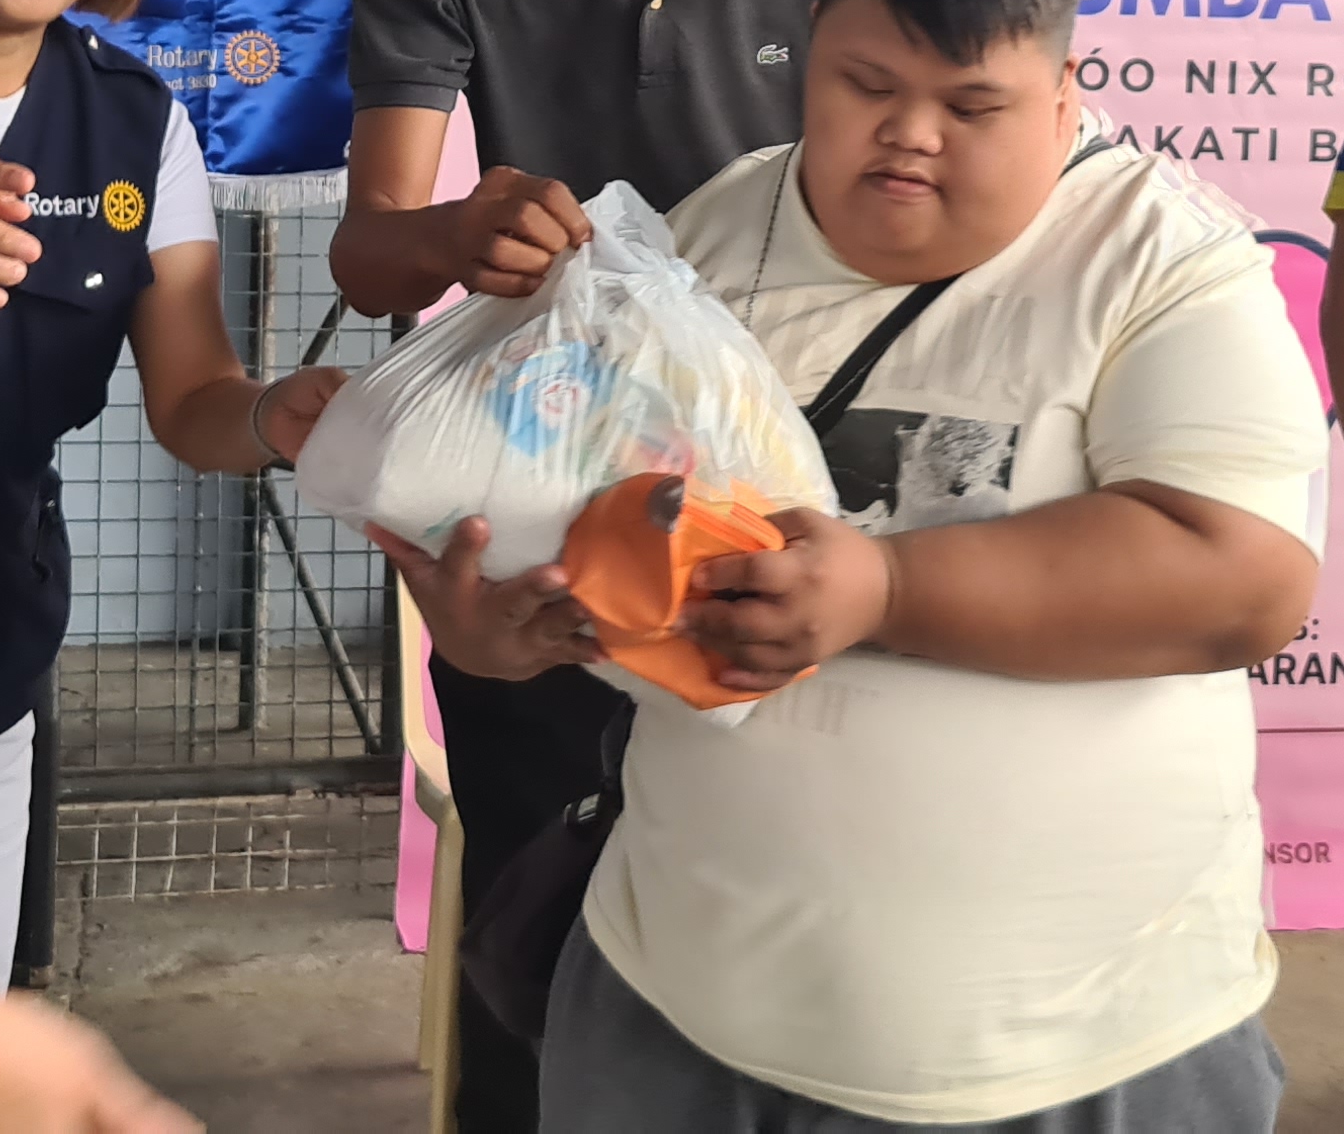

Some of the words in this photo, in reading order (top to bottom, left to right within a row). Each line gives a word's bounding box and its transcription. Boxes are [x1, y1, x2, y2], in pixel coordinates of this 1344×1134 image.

[146, 44, 218, 71] Rotary
[1185, 59, 1278, 96] NIX
[1115, 124, 1278, 163] AKATI
[1308, 128, 1339, 163] B
[24, 192, 100, 219] Rotary
[1264, 842, 1332, 864] NSOR
